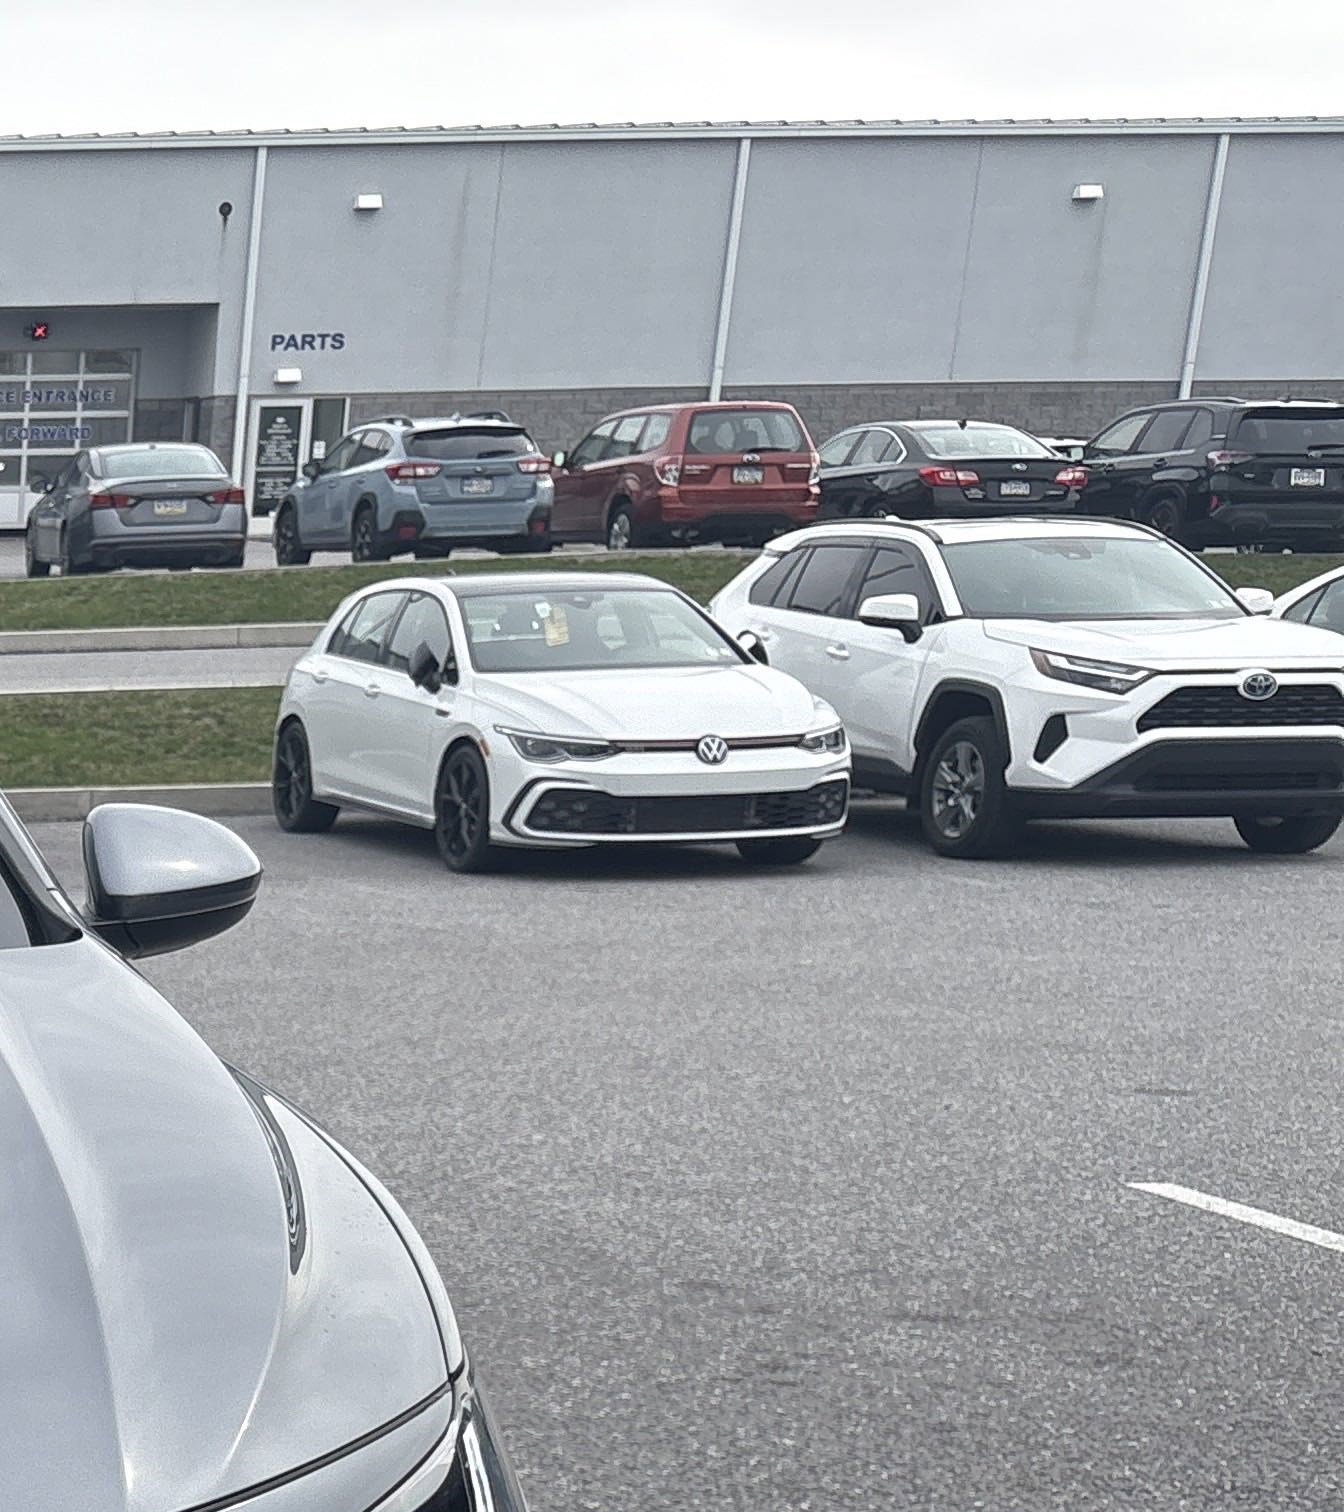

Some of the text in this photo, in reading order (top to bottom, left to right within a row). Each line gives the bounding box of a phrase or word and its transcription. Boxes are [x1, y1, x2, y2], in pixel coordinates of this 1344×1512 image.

[270, 333, 346, 351] PARTS
[22, 389, 113, 403] ENTRANCE
[7, 427, 91, 441] FORWARD
